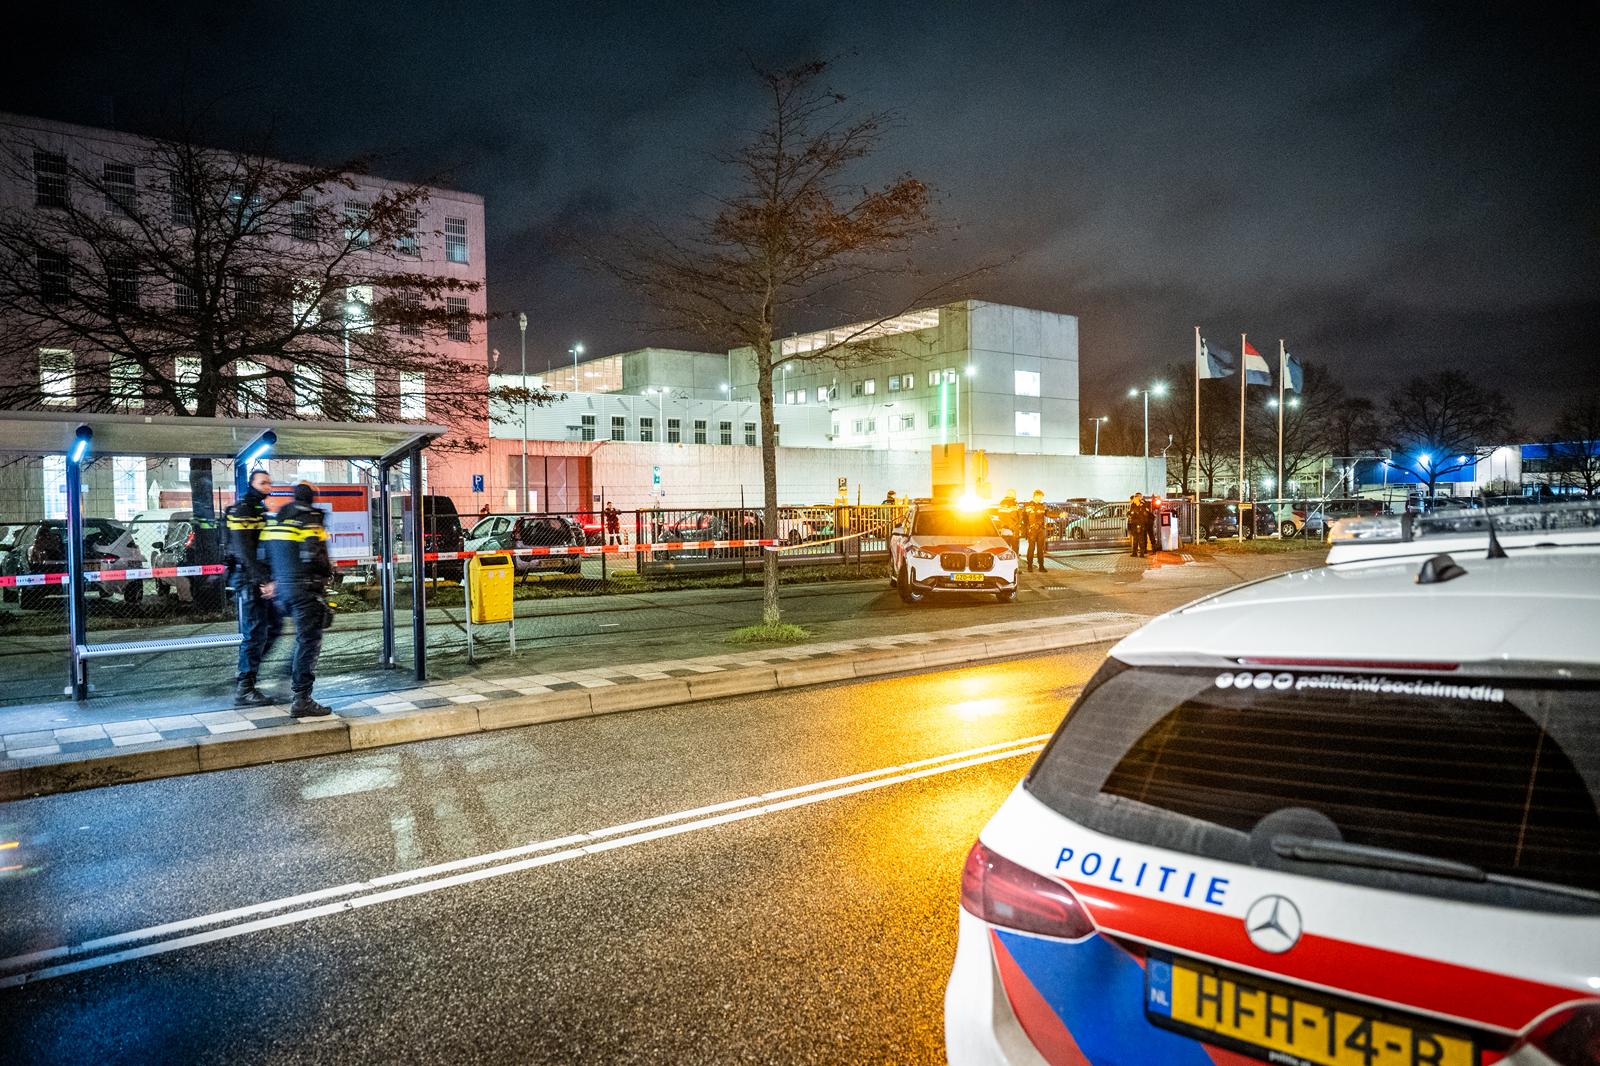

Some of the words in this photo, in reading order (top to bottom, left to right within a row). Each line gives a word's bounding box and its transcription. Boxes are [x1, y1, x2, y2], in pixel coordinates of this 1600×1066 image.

[475, 475, 482, 485] P
[1055, 847, 1230, 906] POLITIE
[1150, 987, 1169, 1007] NL
